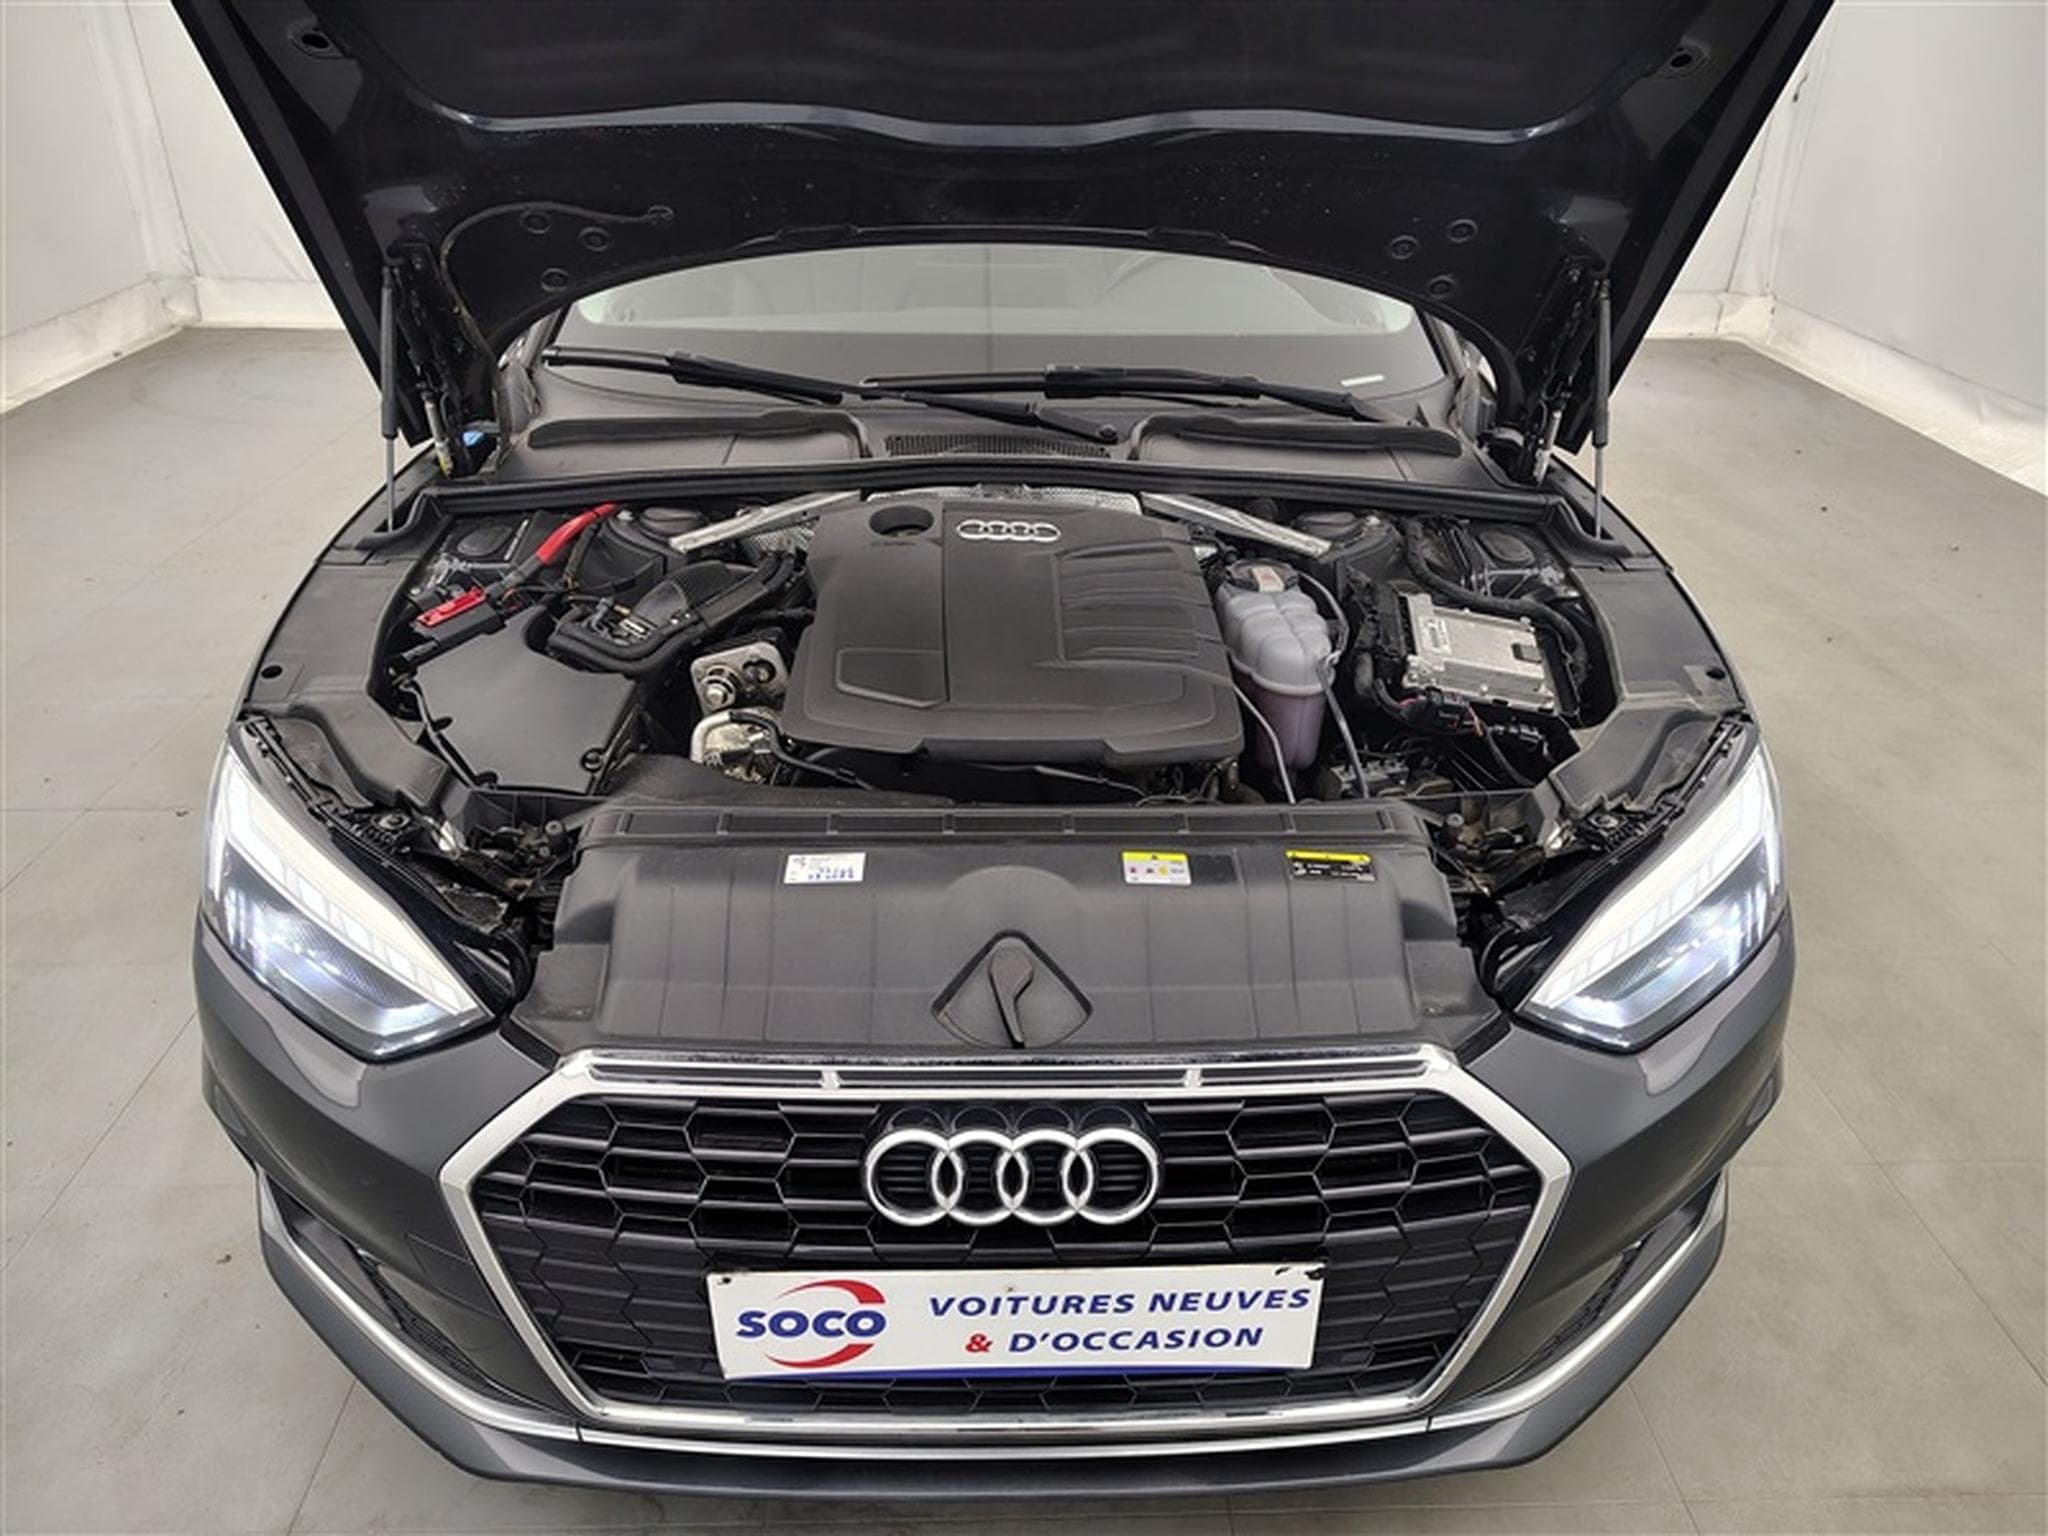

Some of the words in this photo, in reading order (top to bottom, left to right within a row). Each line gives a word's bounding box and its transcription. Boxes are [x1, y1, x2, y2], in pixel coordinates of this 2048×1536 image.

[929, 1293, 1136, 1318] VOITURES
[1148, 1287, 1312, 1313] NEUVES
[736, 1309, 888, 1339] SOCO
[965, 1332, 993, 1355] &
[1008, 1326, 1264, 1354] D'OCCASION
